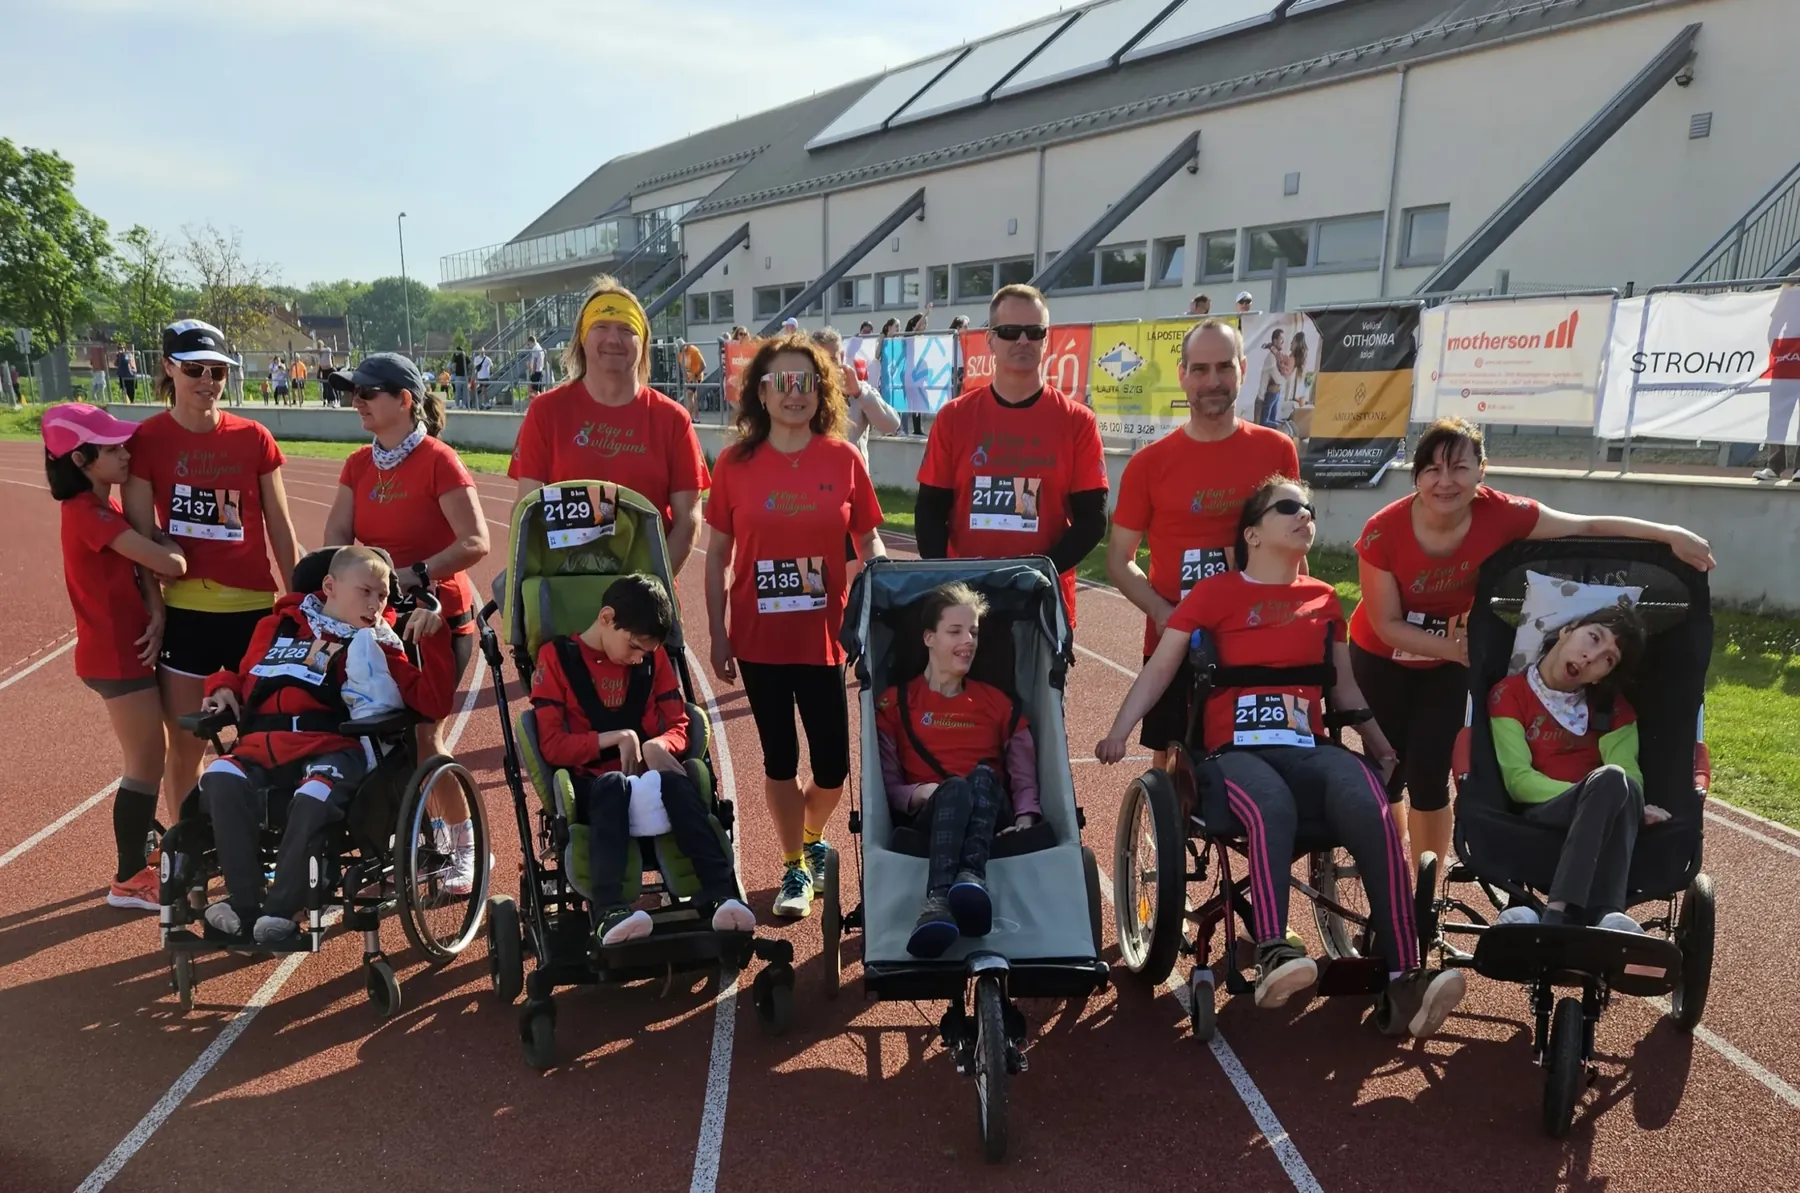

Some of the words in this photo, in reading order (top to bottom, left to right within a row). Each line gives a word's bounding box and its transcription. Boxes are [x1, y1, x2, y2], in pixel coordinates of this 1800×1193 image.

[1147, 330, 1187, 341] LAPOSTET
[1343, 333, 1395, 347] OTTHONRA
[1447, 332, 1541, 351] motherson
[1629, 351, 1755, 373] STROHM
[1333, 411, 1387, 421] AMONSTONE
[597, 423, 621, 438] Egy
[591, 438, 647, 457] világunk
[972, 489, 1014, 506] 2177
[172, 497, 216, 517] 2137
[543, 501, 590, 522] 2129
[1182, 562, 1226, 581] 2133
[1461, 560, 1469, 571] a
[757, 572, 800, 590] 2135
[264, 647, 308, 660] 2128
[601, 676, 623, 692] Egy
[1236, 706, 1285, 723] 2126
